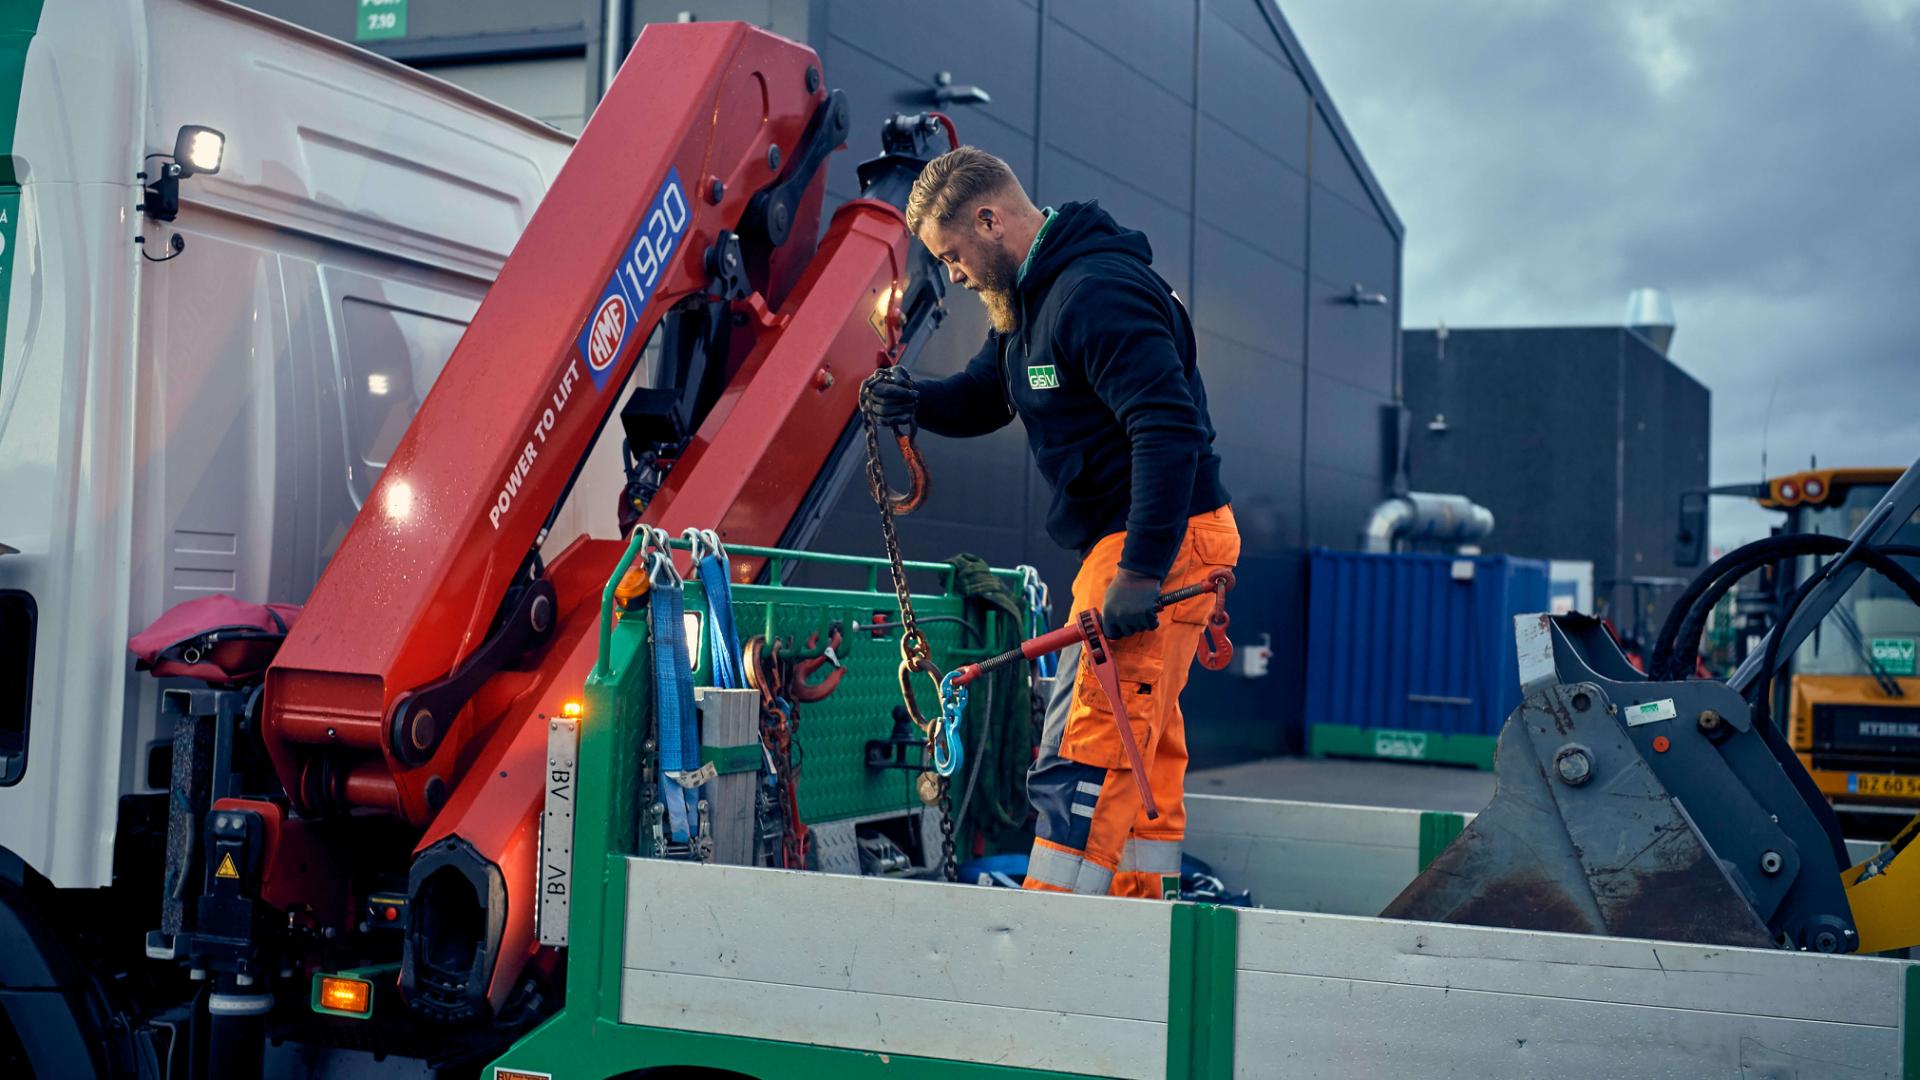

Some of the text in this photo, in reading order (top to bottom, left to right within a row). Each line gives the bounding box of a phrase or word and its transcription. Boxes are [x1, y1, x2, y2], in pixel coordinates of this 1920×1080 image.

[592, 183, 686, 363] HMF 1920
[1030, 374, 1055, 387] GSV
[489, 359, 580, 530] POWER TO LIFT
[1873, 646, 1913, 660] GSV
[1375, 738, 1425, 759] GSV
[551, 770, 570, 801] BV
[547, 864, 566, 895] BV
